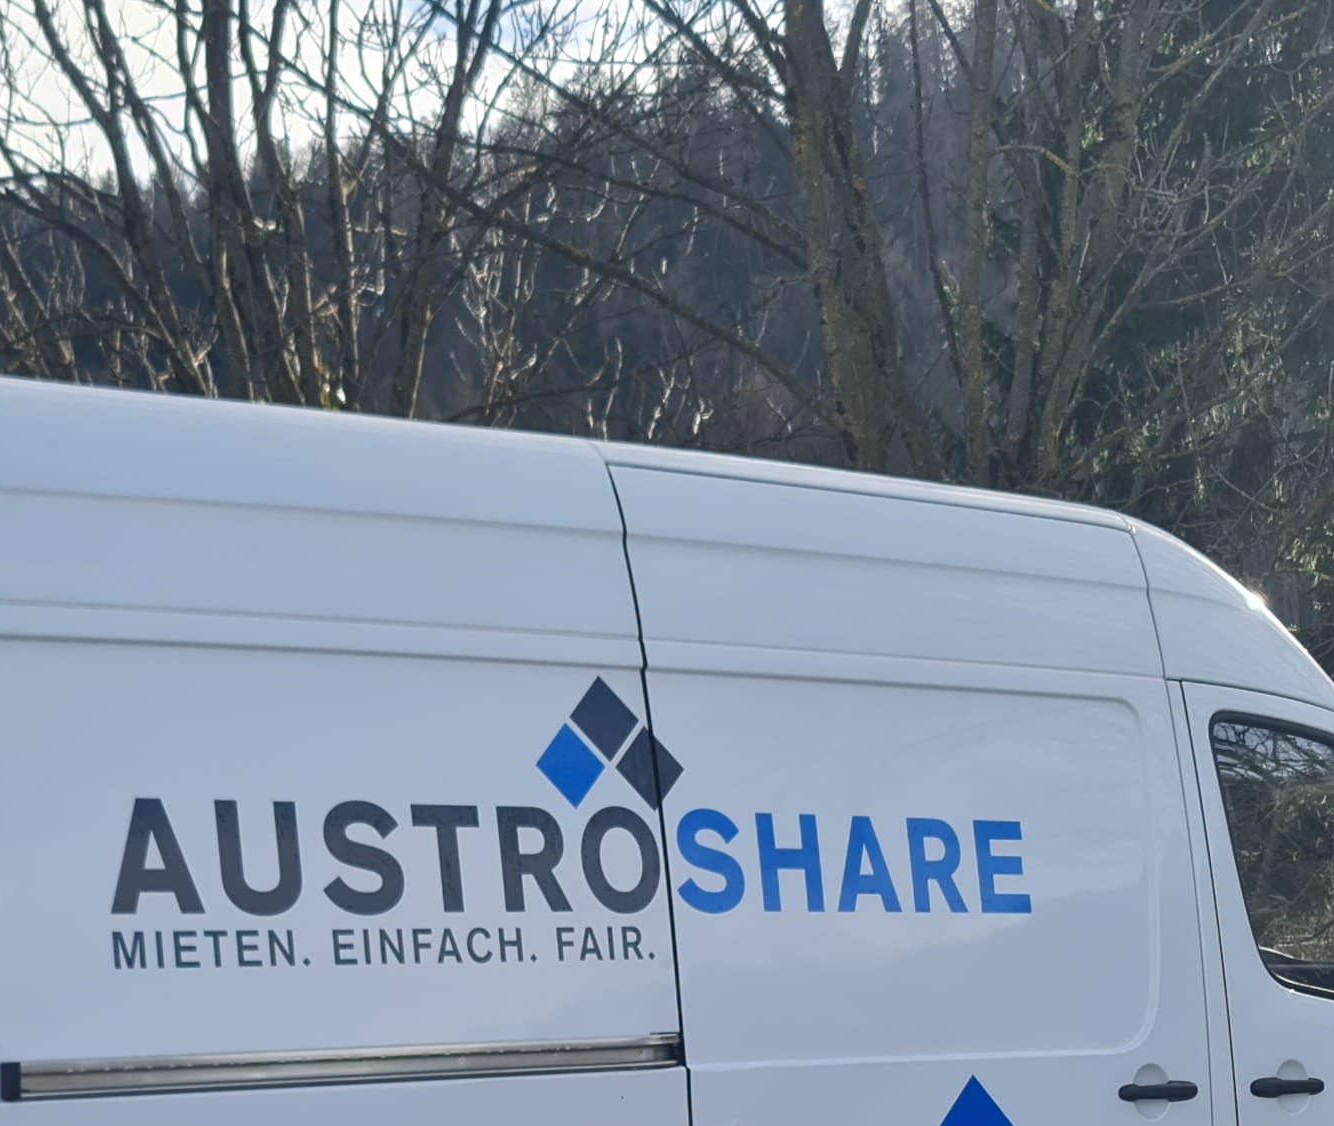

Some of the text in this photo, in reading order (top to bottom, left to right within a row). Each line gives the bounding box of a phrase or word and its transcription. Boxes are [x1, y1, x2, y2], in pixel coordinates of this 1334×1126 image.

[110, 797, 1034, 917] AUSTROSHARE
[111, 924, 656, 970] MIETEN. EINFACH. FAIR.
